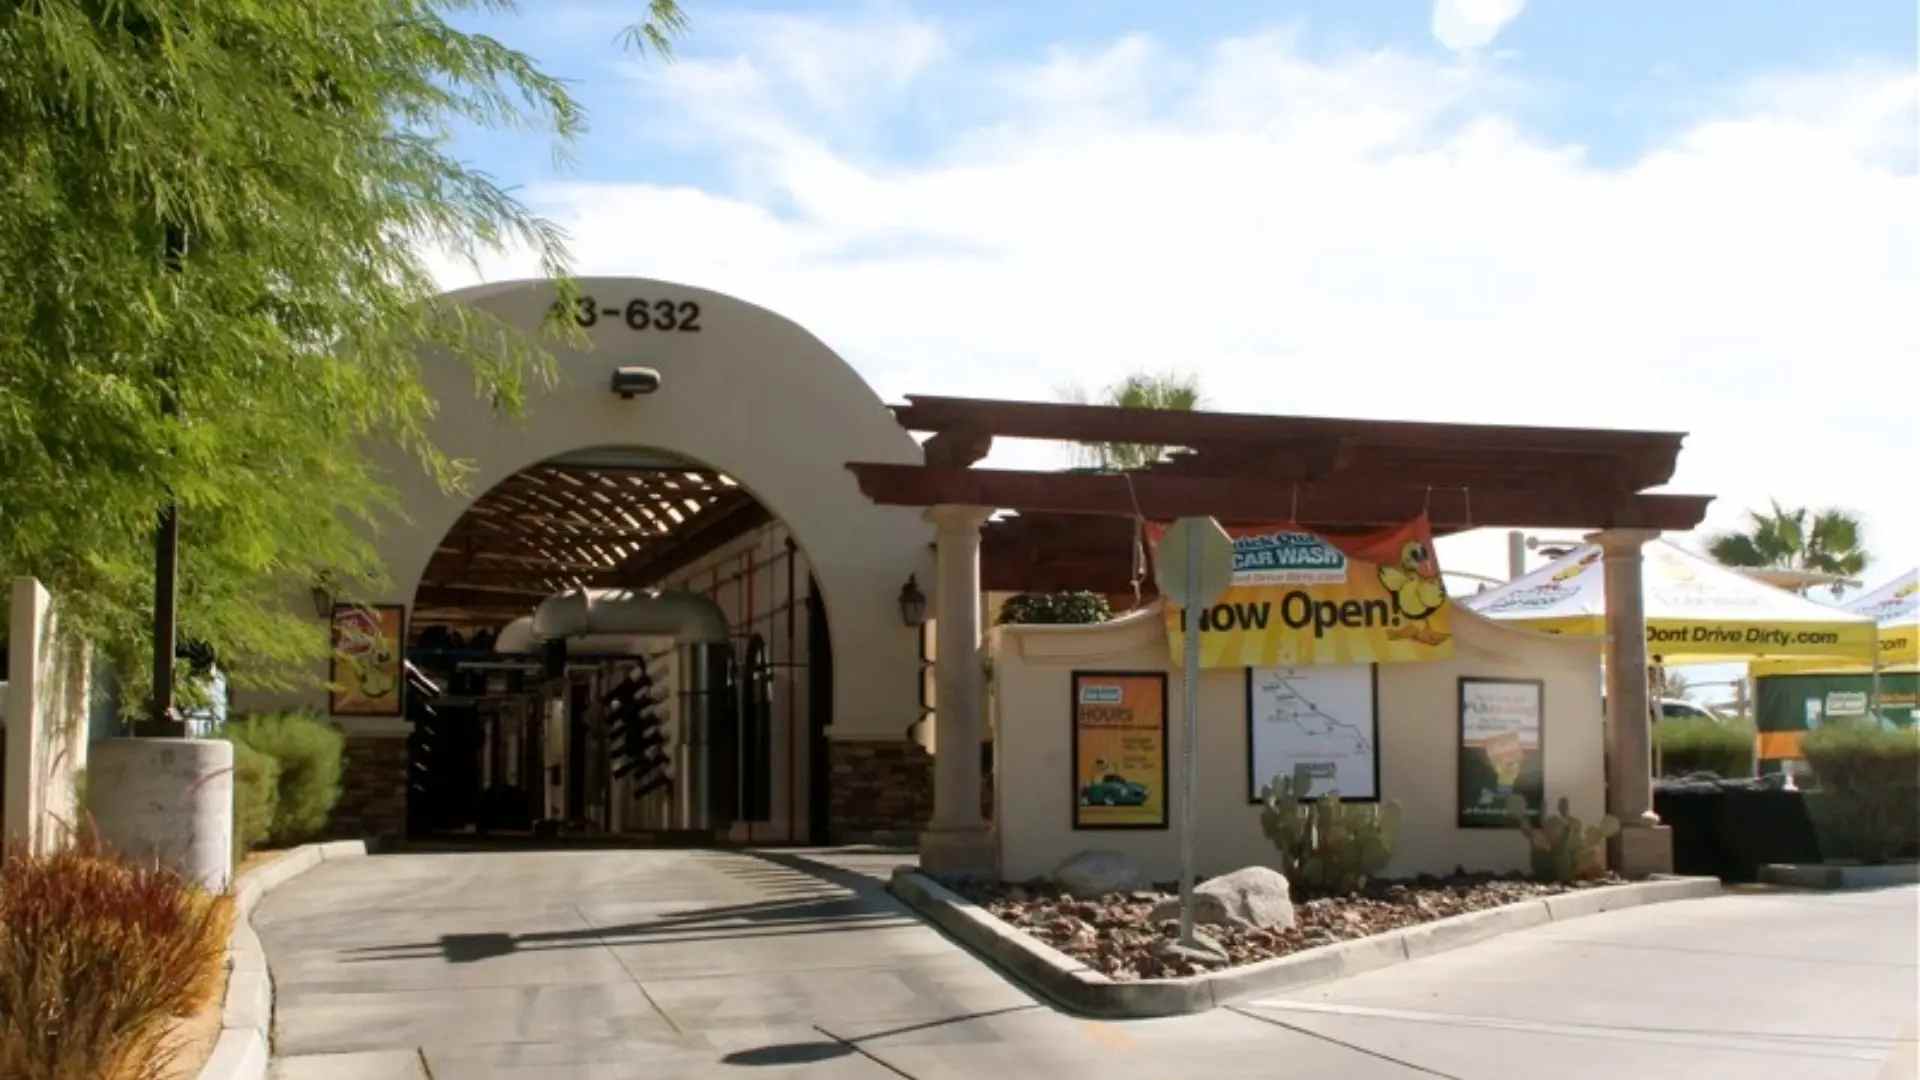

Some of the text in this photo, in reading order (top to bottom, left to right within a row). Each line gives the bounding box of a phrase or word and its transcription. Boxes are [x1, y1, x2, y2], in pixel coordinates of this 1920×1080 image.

[1276, 547, 1339, 565] WASH
[1281, 590, 1401, 638] Open!
[1692, 626, 1743, 642] Drive
[1746, 627, 1839, 646] Dirty.com
